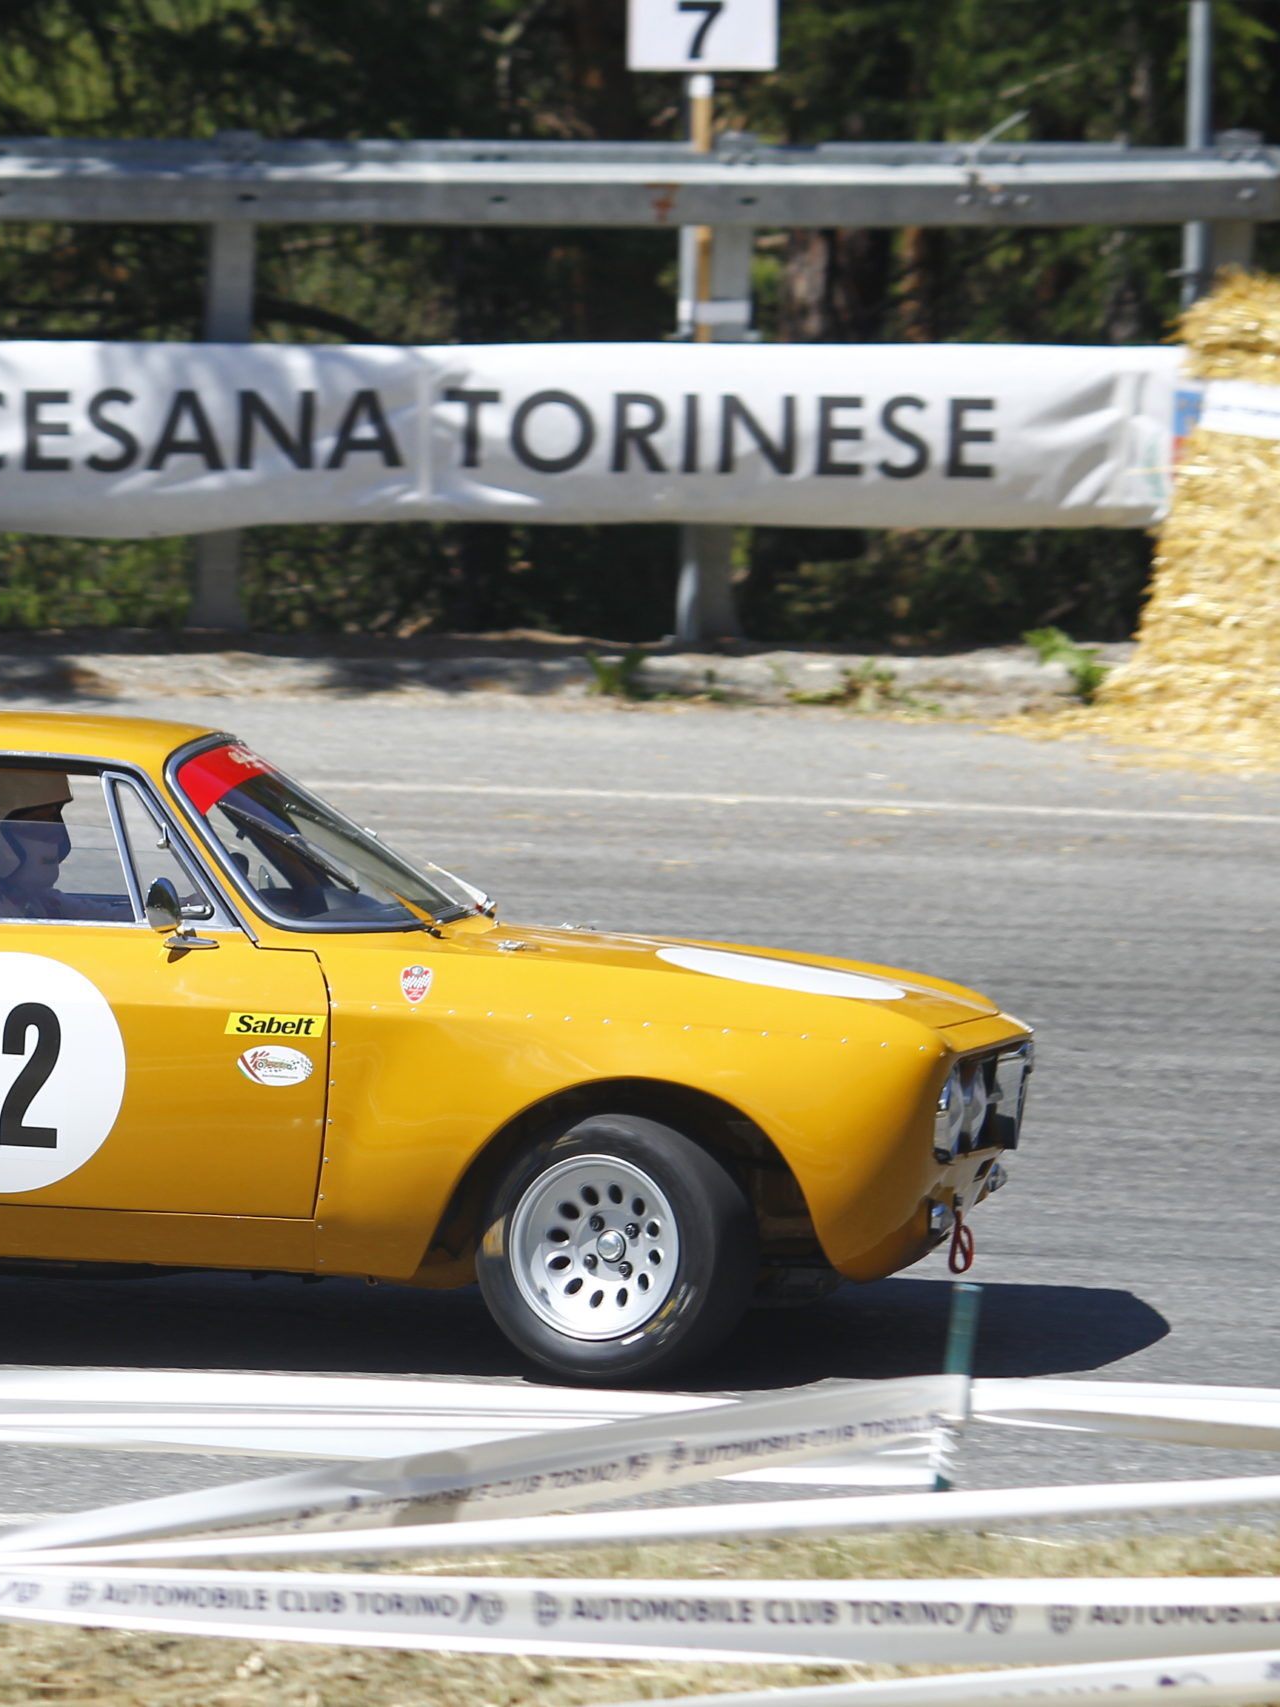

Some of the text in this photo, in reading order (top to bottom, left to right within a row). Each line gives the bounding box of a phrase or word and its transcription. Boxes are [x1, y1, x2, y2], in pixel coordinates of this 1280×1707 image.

[677, 0, 725, 60] 7
[442, 389, 997, 480] TORINESE
[235, 1014, 316, 1036] Sabelt
[103, 1583, 459, 1618] AUTOMOBILE CLUB TORINO
[572, 1598, 964, 1627] AUTOMOBILE CLUB TORINO
